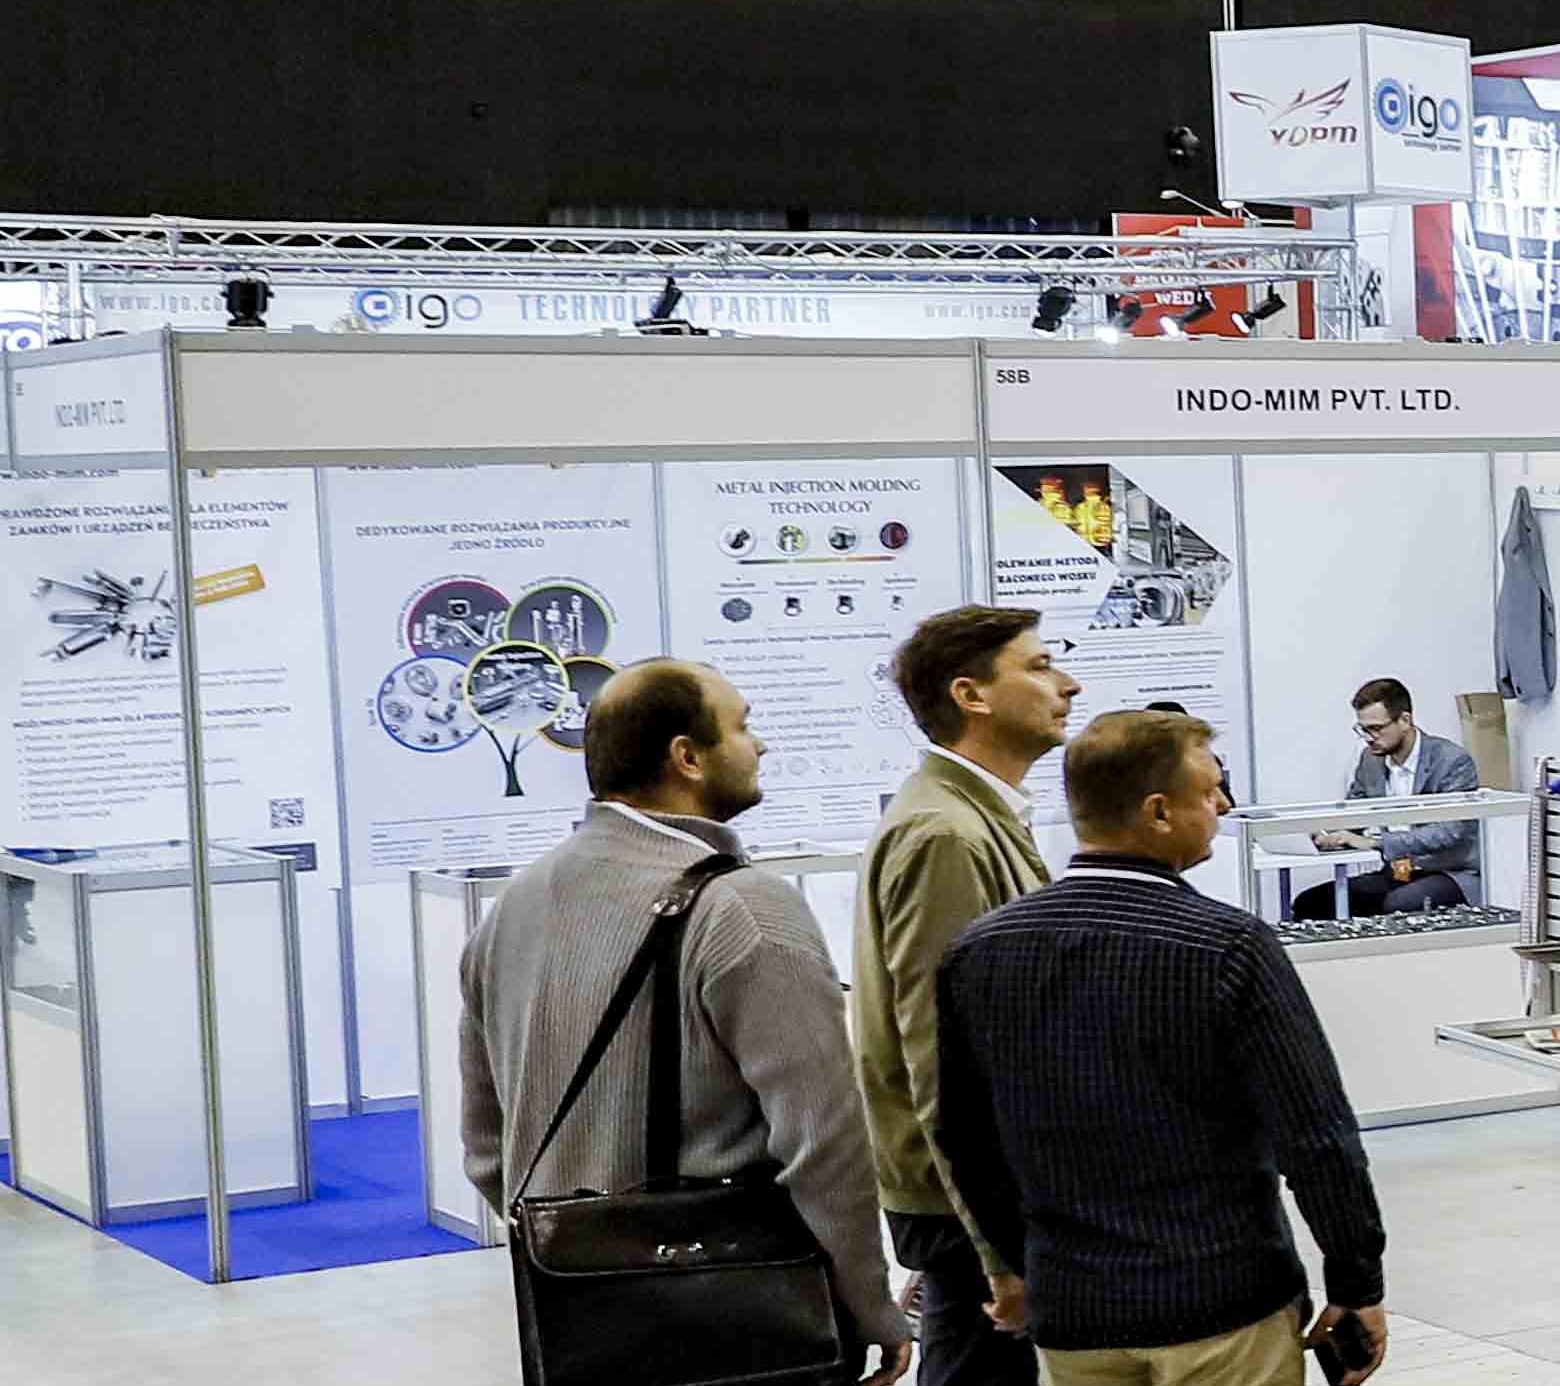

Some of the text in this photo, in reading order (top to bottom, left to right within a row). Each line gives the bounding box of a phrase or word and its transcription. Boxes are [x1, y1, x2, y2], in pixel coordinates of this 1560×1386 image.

[1408, 85, 1461, 138] igo
[100, 292, 223, 313] www.igo.co
[710, 296, 831, 324] PARTNER
[996, 368, 1031, 385] 58B
[1176, 388, 1461, 412] INDO-MIM PVT. LTD.
[716, 479, 921, 495] METAL INJECTION MOLDING
[768, 500, 872, 514] TECHNOLOGY
[356, 524, 448, 537] DEDYKOWANE
[543, 518, 632, 530] PRODUKCYJNE
[450, 538, 491, 550] JEDNO
[1059, 571, 1097, 581] WOSKU
